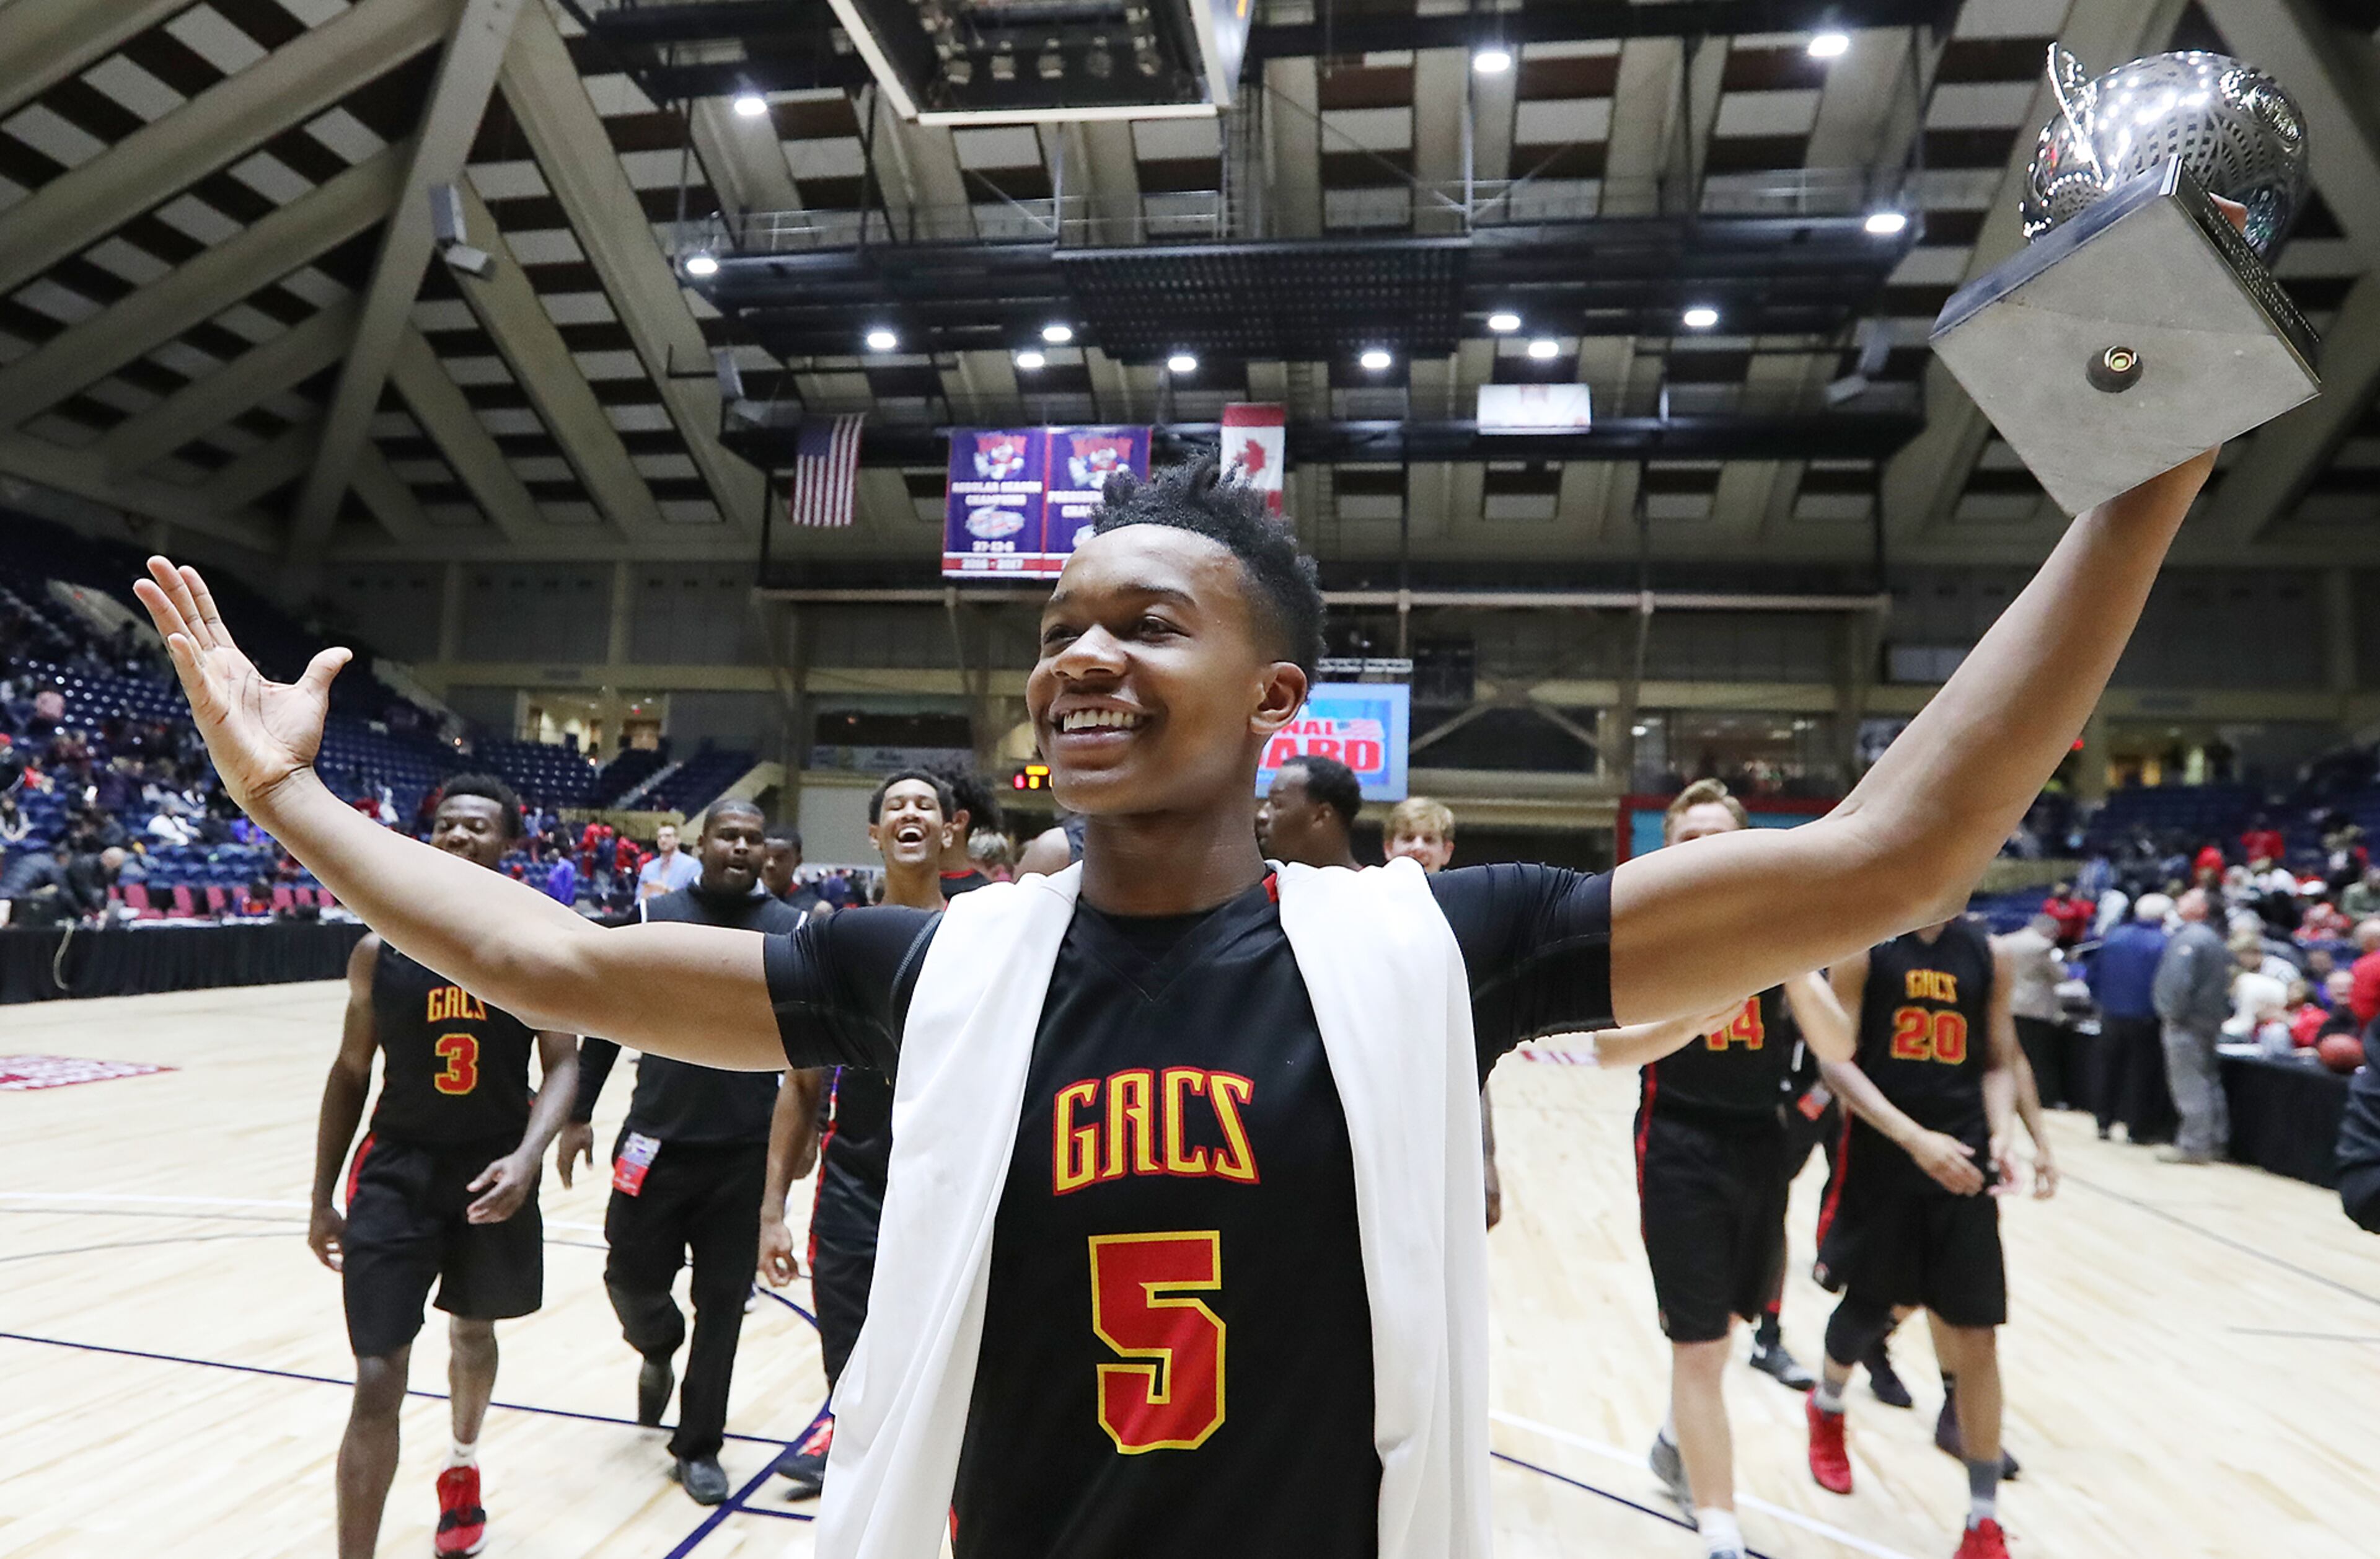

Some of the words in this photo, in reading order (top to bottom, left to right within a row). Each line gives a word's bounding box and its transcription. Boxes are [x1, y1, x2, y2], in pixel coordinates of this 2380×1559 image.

[1258, 738, 1380, 770] ARD
[434, 1033, 479, 1095] 3
[1890, 1005, 1968, 1066] 20
[1054, 1065, 1261, 1197] GACS
[1088, 1230, 1227, 1455] 5
